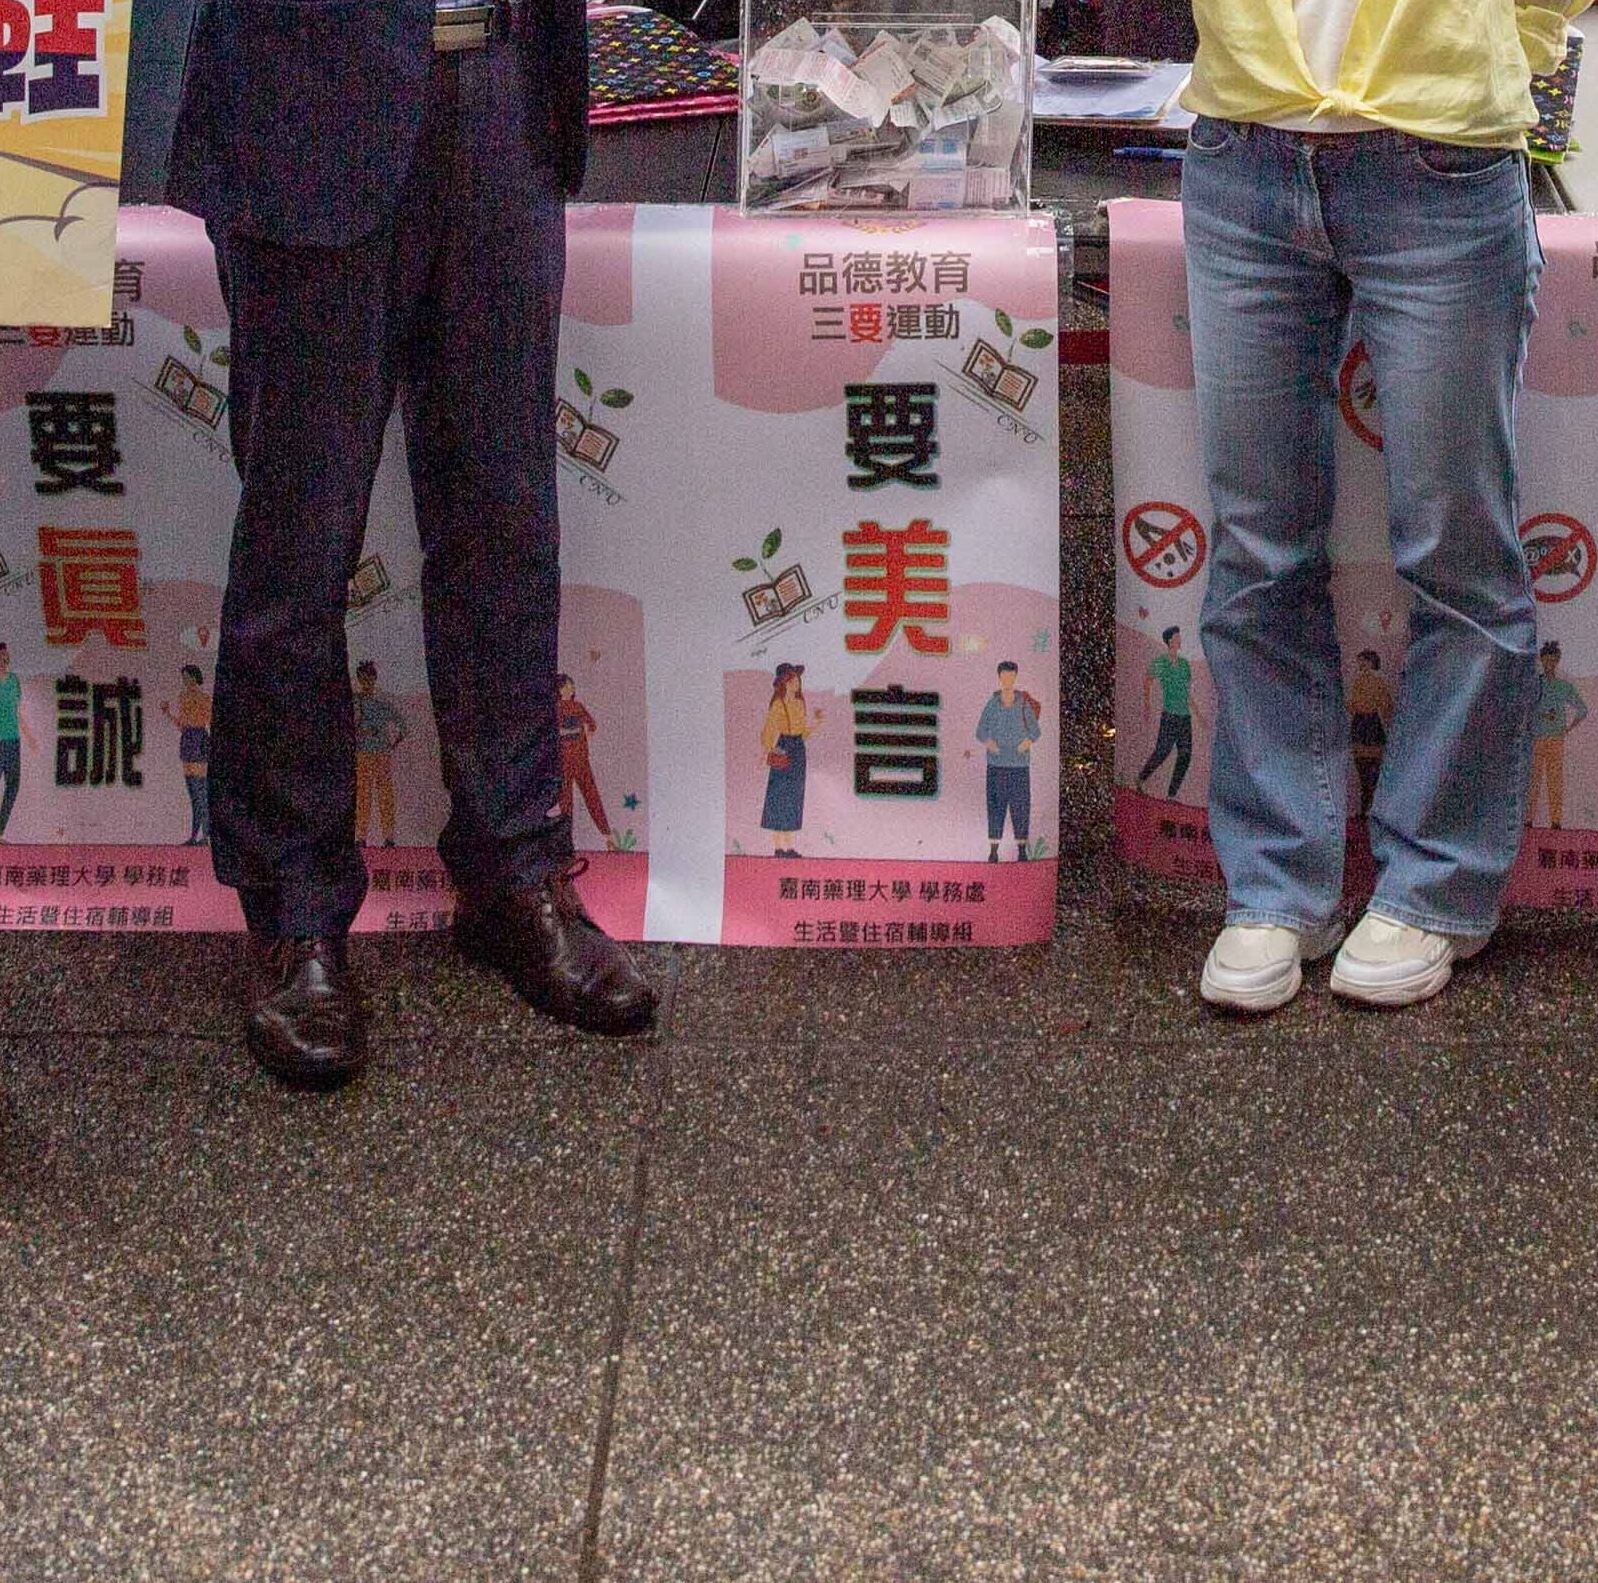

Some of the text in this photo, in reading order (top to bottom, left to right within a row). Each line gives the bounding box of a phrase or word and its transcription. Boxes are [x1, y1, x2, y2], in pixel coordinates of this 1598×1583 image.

[798, 251, 972, 296] 品德教育
[810, 302, 962, 344] 三要運動
[842, 381, 952, 802] 要美言
[122, 865, 191, 890] 學務處
[779, 876, 987, 904] 嘉南藥理大學 學務處
[792, 919, 975, 944] 生活暨住宿輔導組
